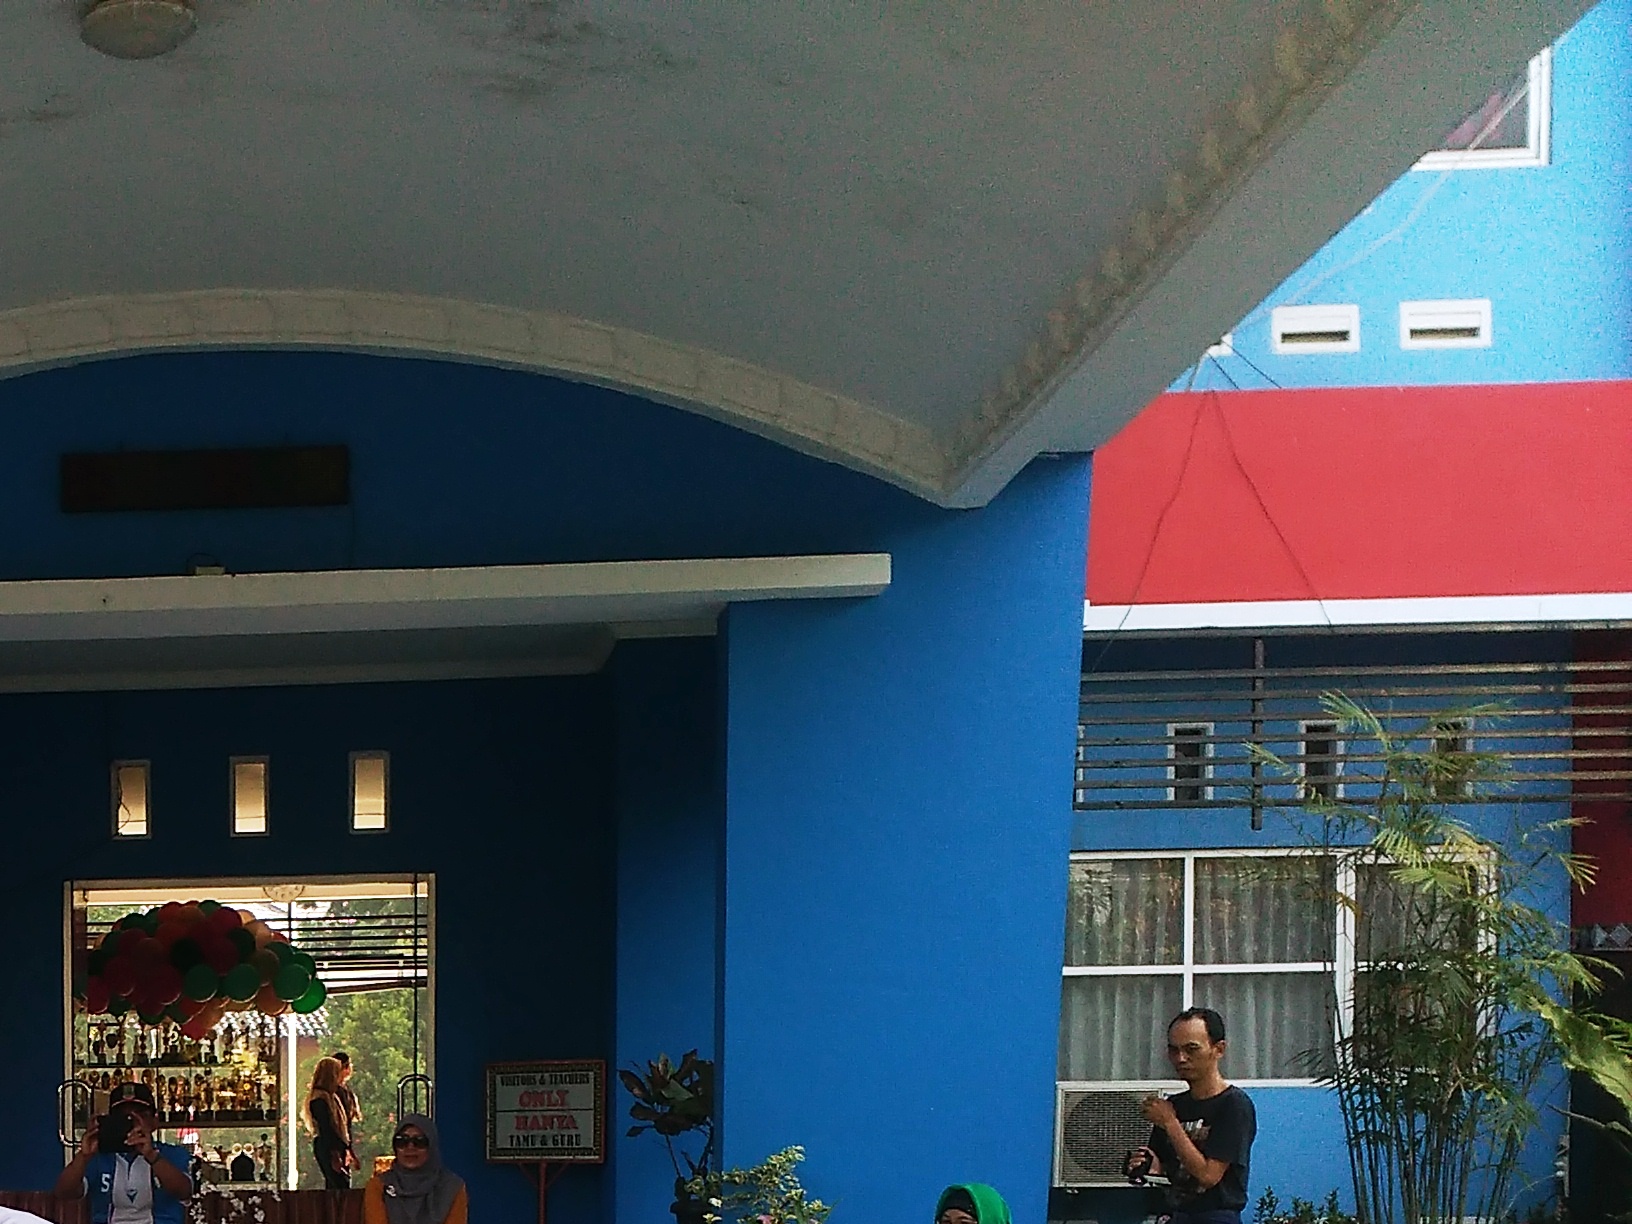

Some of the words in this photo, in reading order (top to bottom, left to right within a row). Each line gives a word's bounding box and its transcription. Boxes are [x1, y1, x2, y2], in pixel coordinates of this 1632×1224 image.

[519, 1090, 569, 1107] ONLY
[515, 1115, 578, 1130] HANYA
[509, 1134, 537, 1147] TAMU
[552, 1133, 581, 1147] GURU
